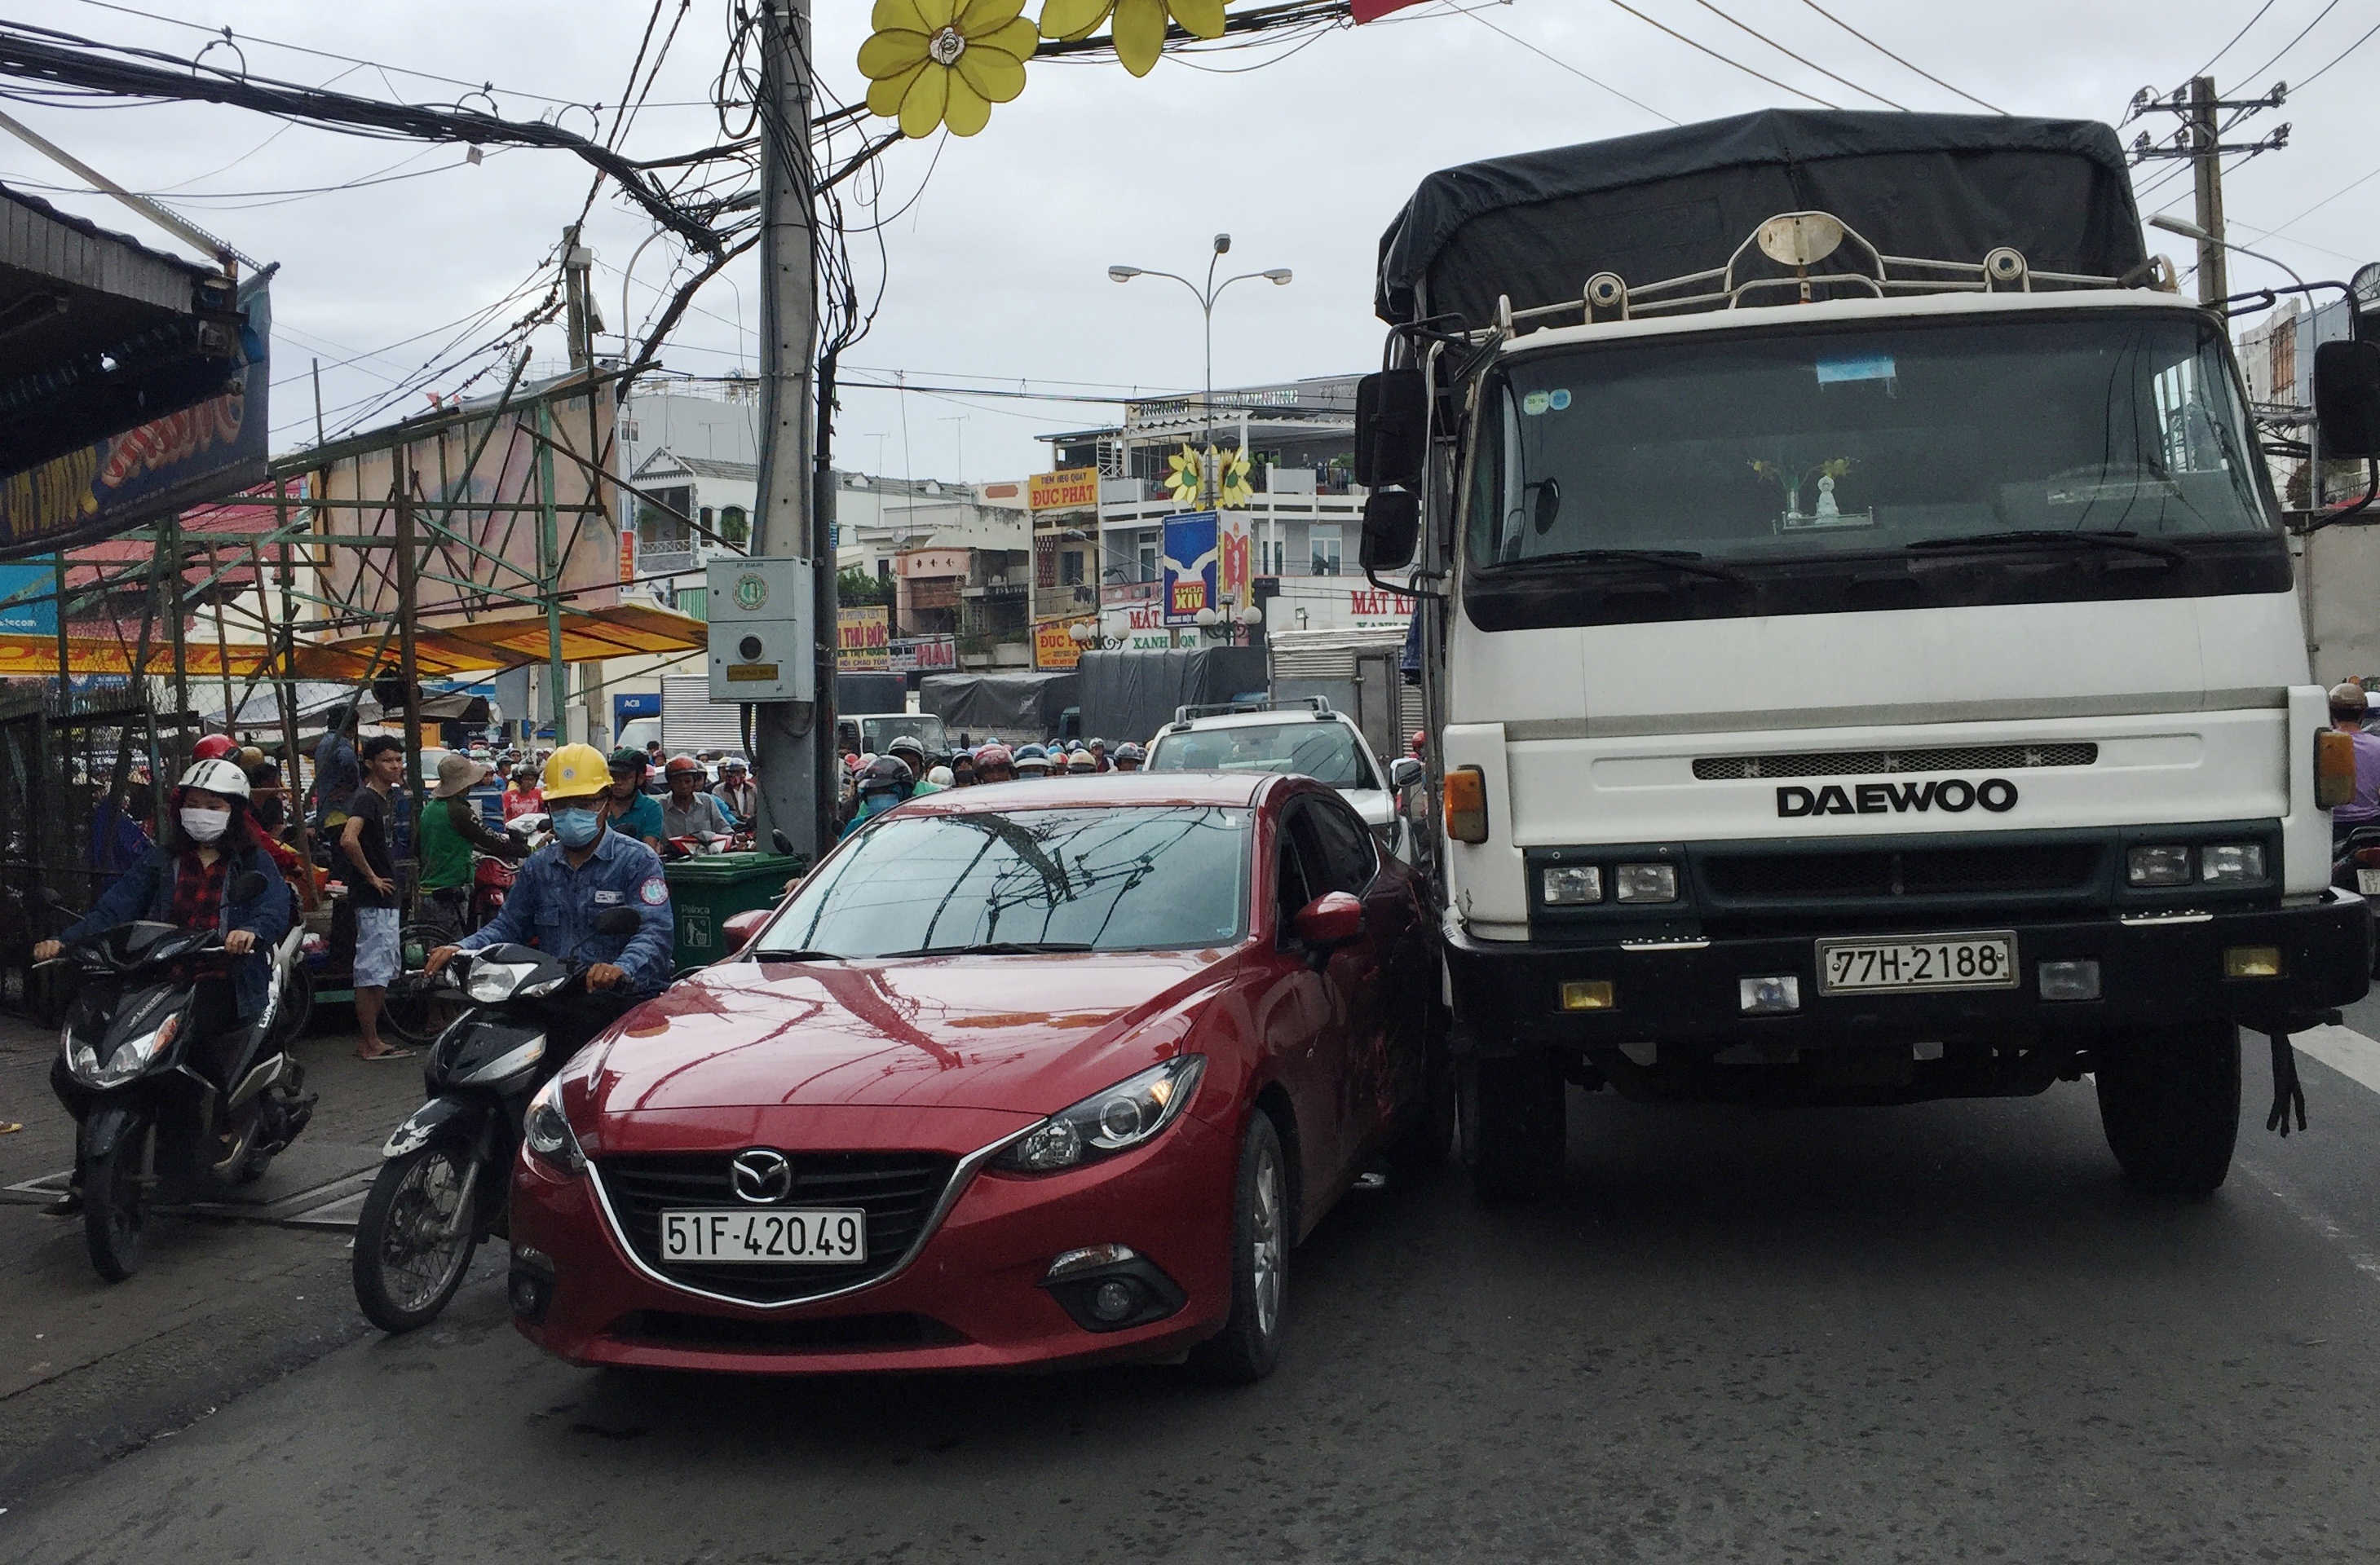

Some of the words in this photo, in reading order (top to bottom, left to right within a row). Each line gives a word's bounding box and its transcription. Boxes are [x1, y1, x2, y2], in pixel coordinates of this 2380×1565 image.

[1058, 474, 1069, 483] HEO
[1175, 593, 1203, 609] XIV
[1133, 636, 1168, 649] XANH
[625, 699, 640, 708] ACB
[1777, 778, 2018, 818] DAEWOO
[1835, 945, 1998, 983] 77H-2188
[668, 1216, 857, 1256] 51F-420.49
